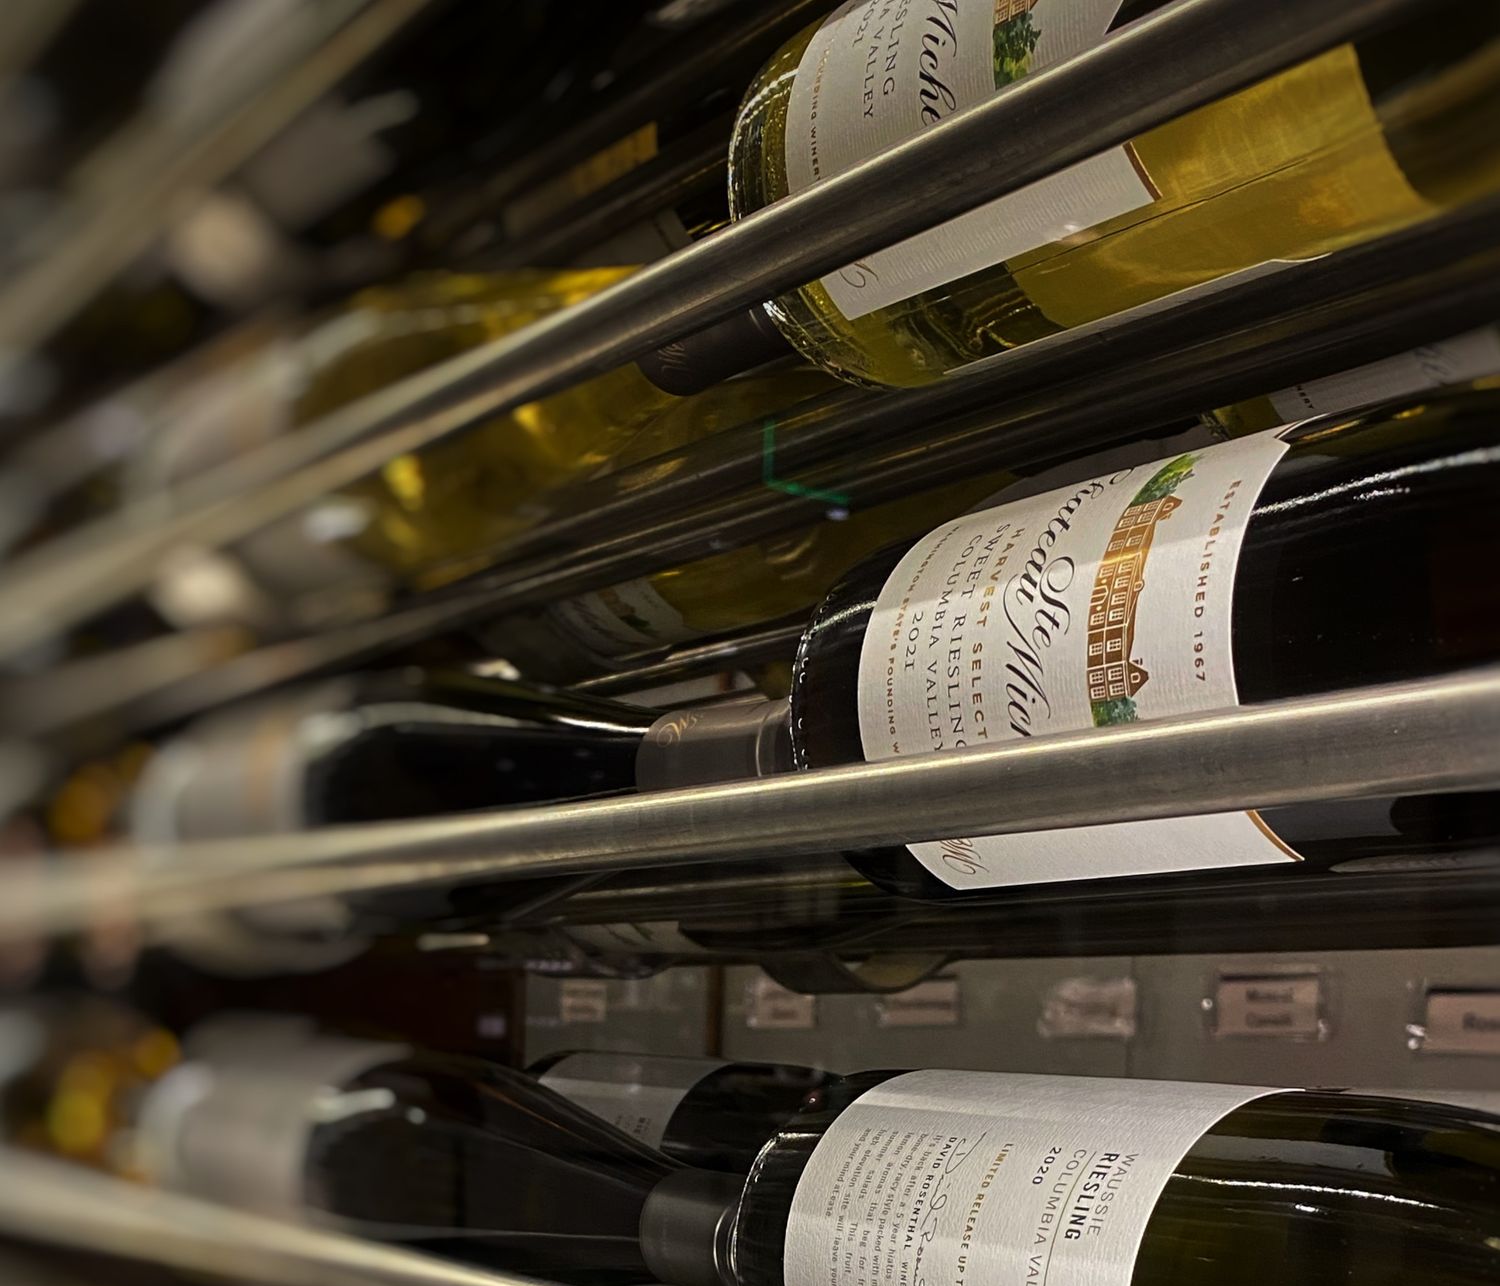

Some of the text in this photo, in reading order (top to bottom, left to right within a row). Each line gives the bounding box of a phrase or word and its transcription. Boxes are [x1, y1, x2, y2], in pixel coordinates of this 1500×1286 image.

[863, 26, 885, 118] VALLEY
[962, 523, 1011, 599] SWEET
[928, 534, 983, 648] COLUMBIA
[1193, 479, 1242, 682] ESTABLISHED 1967
[1032, 556, 1075, 650] Ste
[905, 611, 924, 672] 2021
[971, 528, 1026, 739] HARVEST SELECT
[886, 657, 897, 735] FOUNDING
[875, 1130, 899, 1162] summer
[895, 1131, 914, 1155] lemon
[932, 1137, 958, 1169] DAVID
[849, 1150, 872, 1187] elevation
[914, 1151, 932, 1171] back
[981, 1143, 1014, 1188] LIMITED
[1032, 1146, 1062, 1185] 2020
[874, 1162, 893, 1195] aromas
[891, 1172, 903, 1193] racy
[1087, 1153, 1140, 1236] WAUSSIE
[866, 1202, 878, 1221] that
[882, 1194, 894, 1216] style
[904, 1174, 934, 1250] ROSENTHAL
[1034, 1149, 1087, 1245] COLUMBIA
[1064, 1153, 1120, 1240] RIESLING
[836, 1215, 844, 1231] will
[848, 1222, 858, 1242] This
[860, 1229, 870, 1247] beg
[875, 1218, 887, 1252] packed
[890, 1222, 900, 1243] year
[961, 1193, 985, 1250] RELEASE
[832, 1237, 842, 1262] leave
[859, 1255, 867, 1270] for
[872, 1255, 880, 1275] with
[957, 1255, 967, 1273] UP
